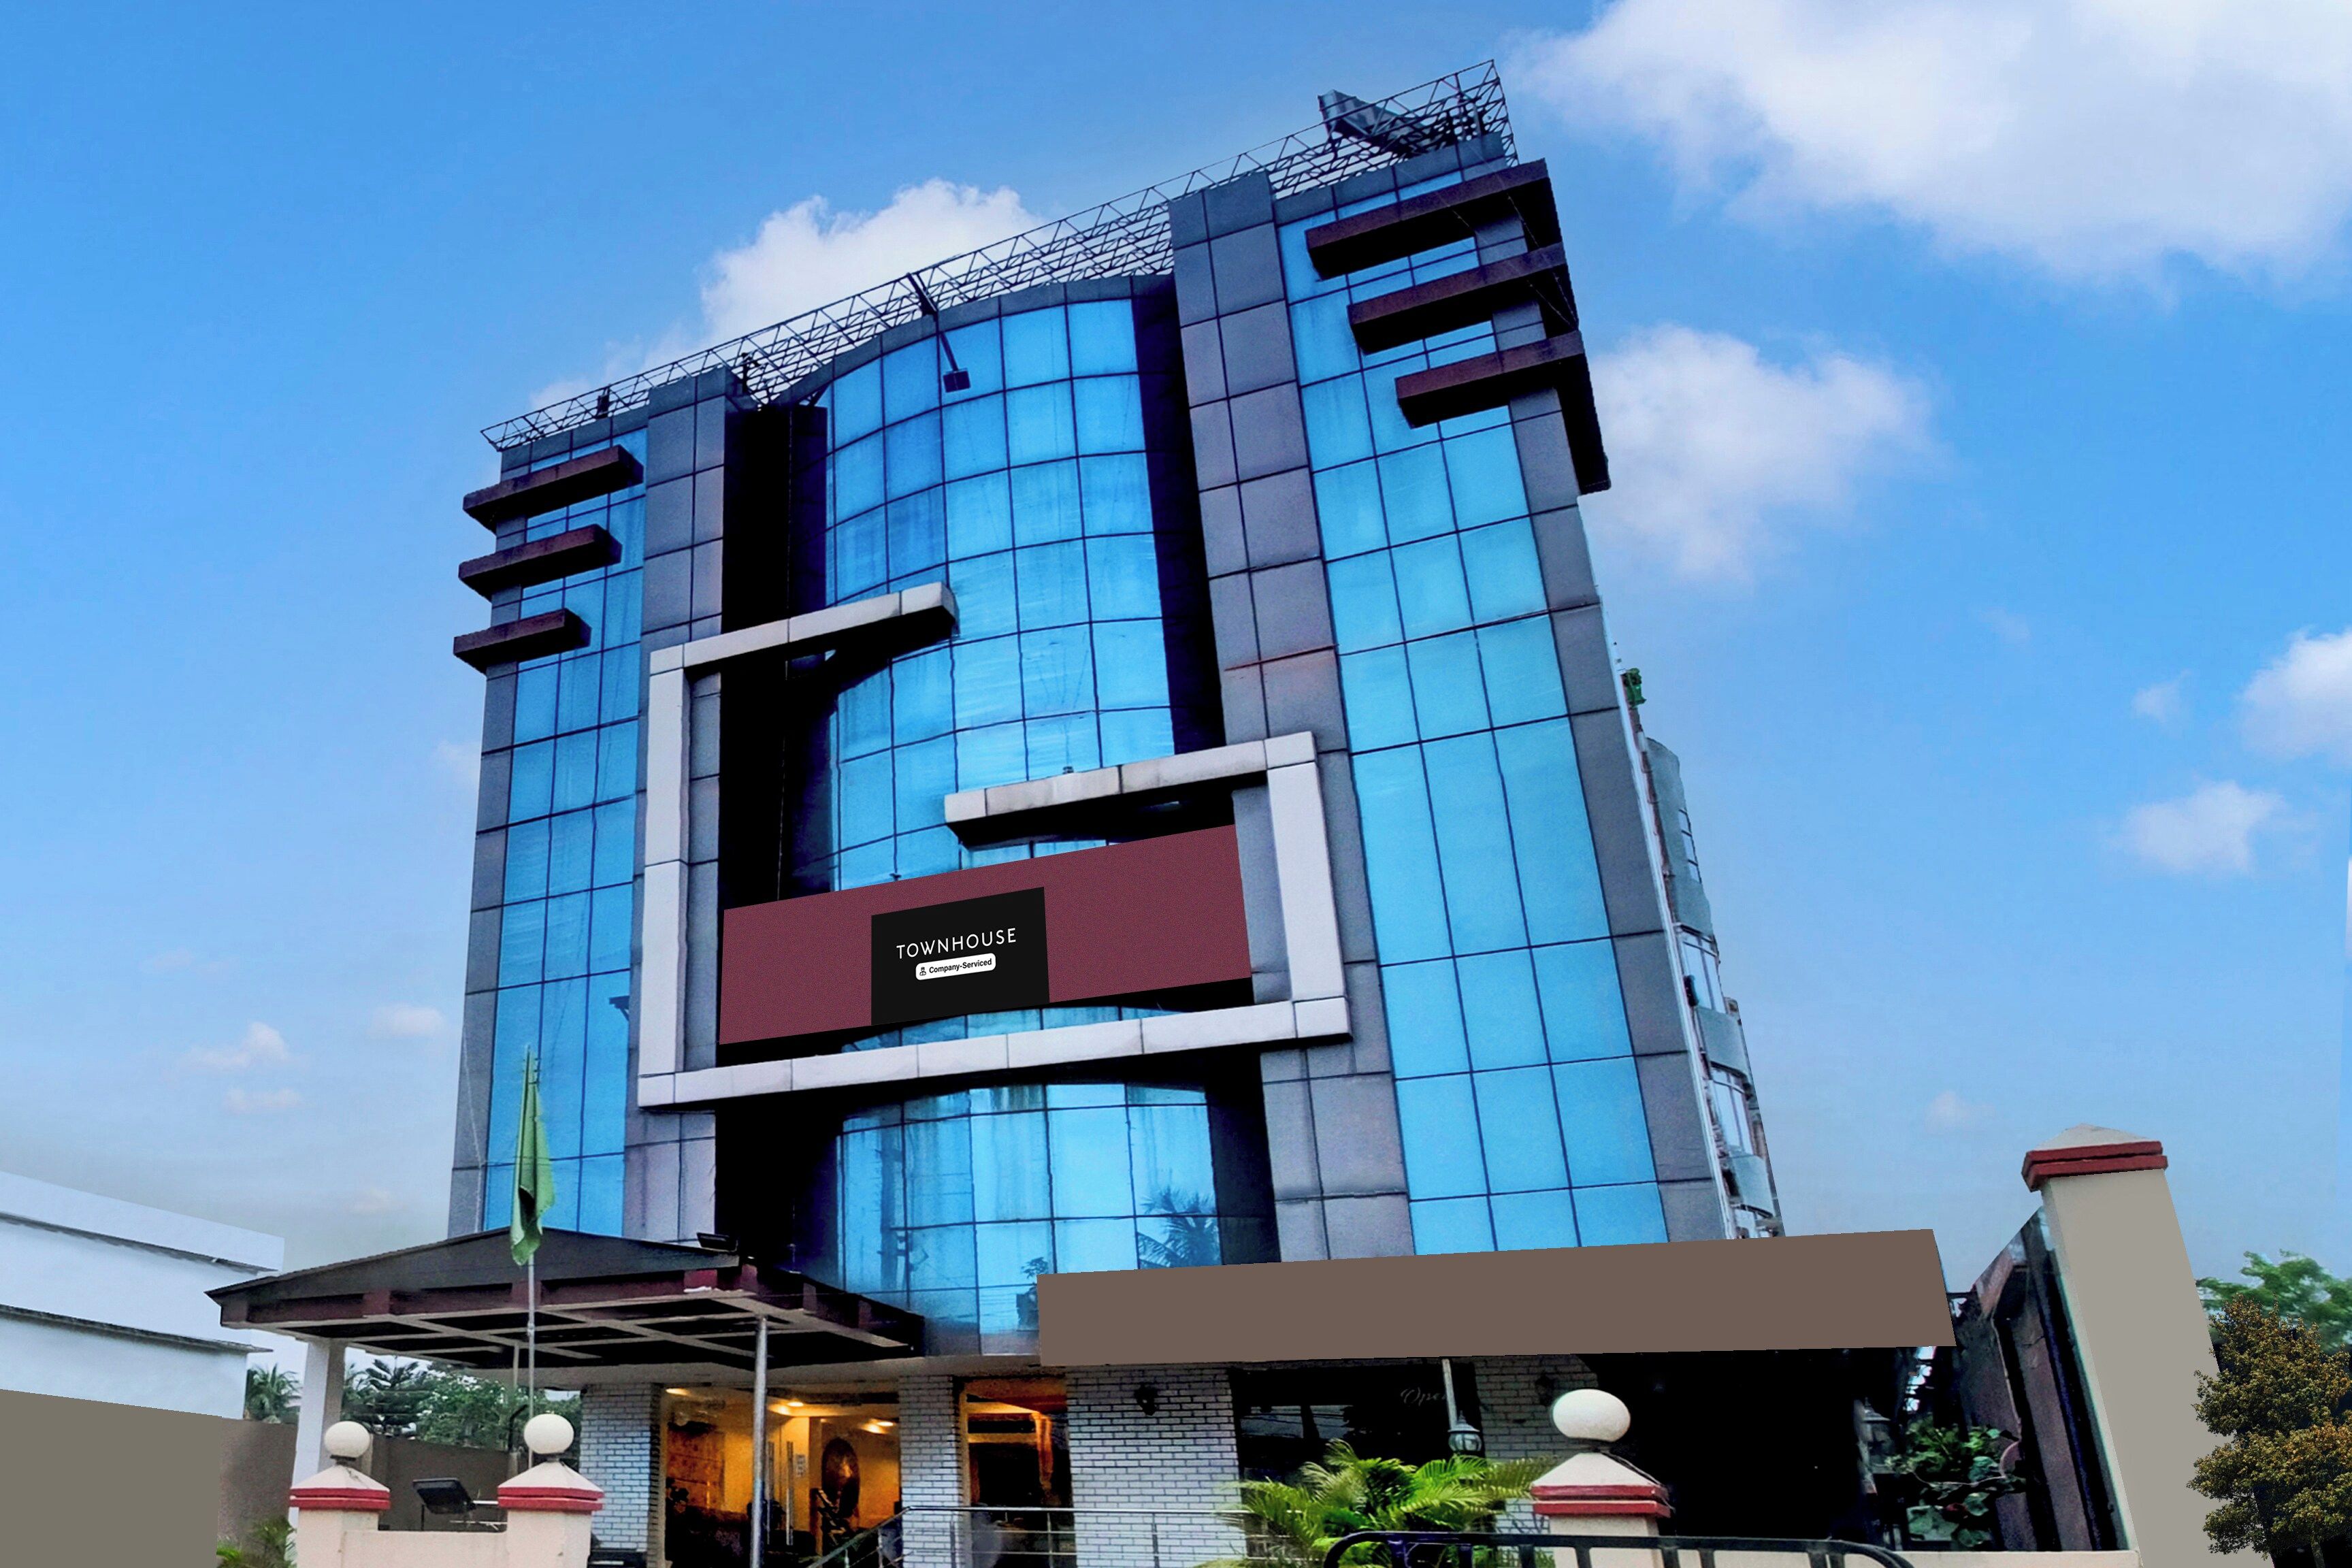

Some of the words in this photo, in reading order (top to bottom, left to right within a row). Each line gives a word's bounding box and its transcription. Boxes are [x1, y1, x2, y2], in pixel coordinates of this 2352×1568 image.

[896, 928, 1016, 959] TOWNHOUSE
[929, 958, 992, 974] Company-Serviced
[1400, 1387, 1446, 1407] Ope
